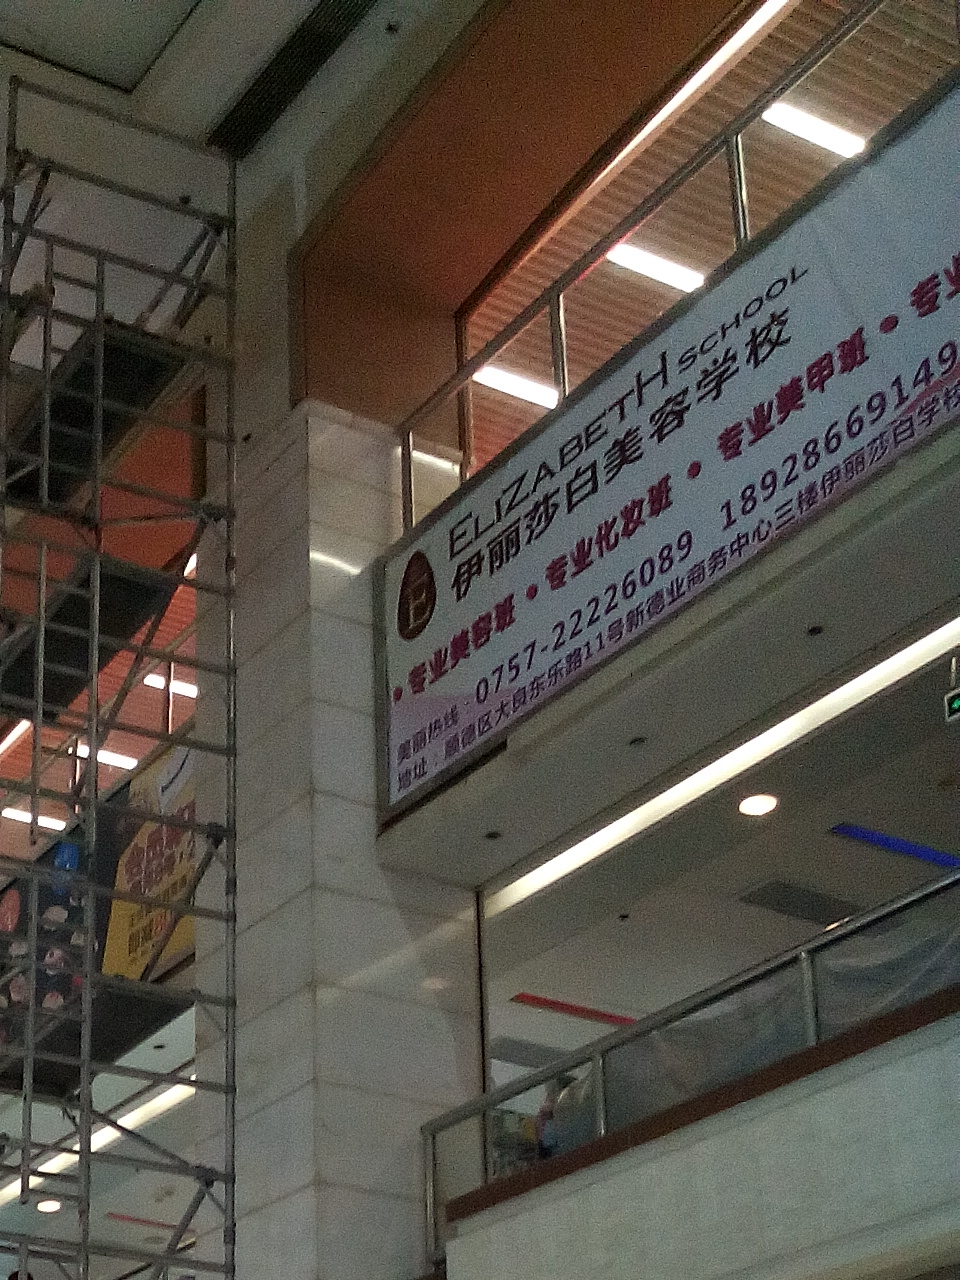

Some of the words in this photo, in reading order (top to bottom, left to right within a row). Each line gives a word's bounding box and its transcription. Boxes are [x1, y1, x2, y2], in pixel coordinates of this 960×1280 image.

[448, 350, 669, 562] ELIZABETH
[678, 265, 809, 375] SCHOOL
[451, 305, 792, 602] 伊丽莎白美容学校
[475, 529, 693, 704] 0757-22226089
[720, 340, 958, 531] 18928669149
